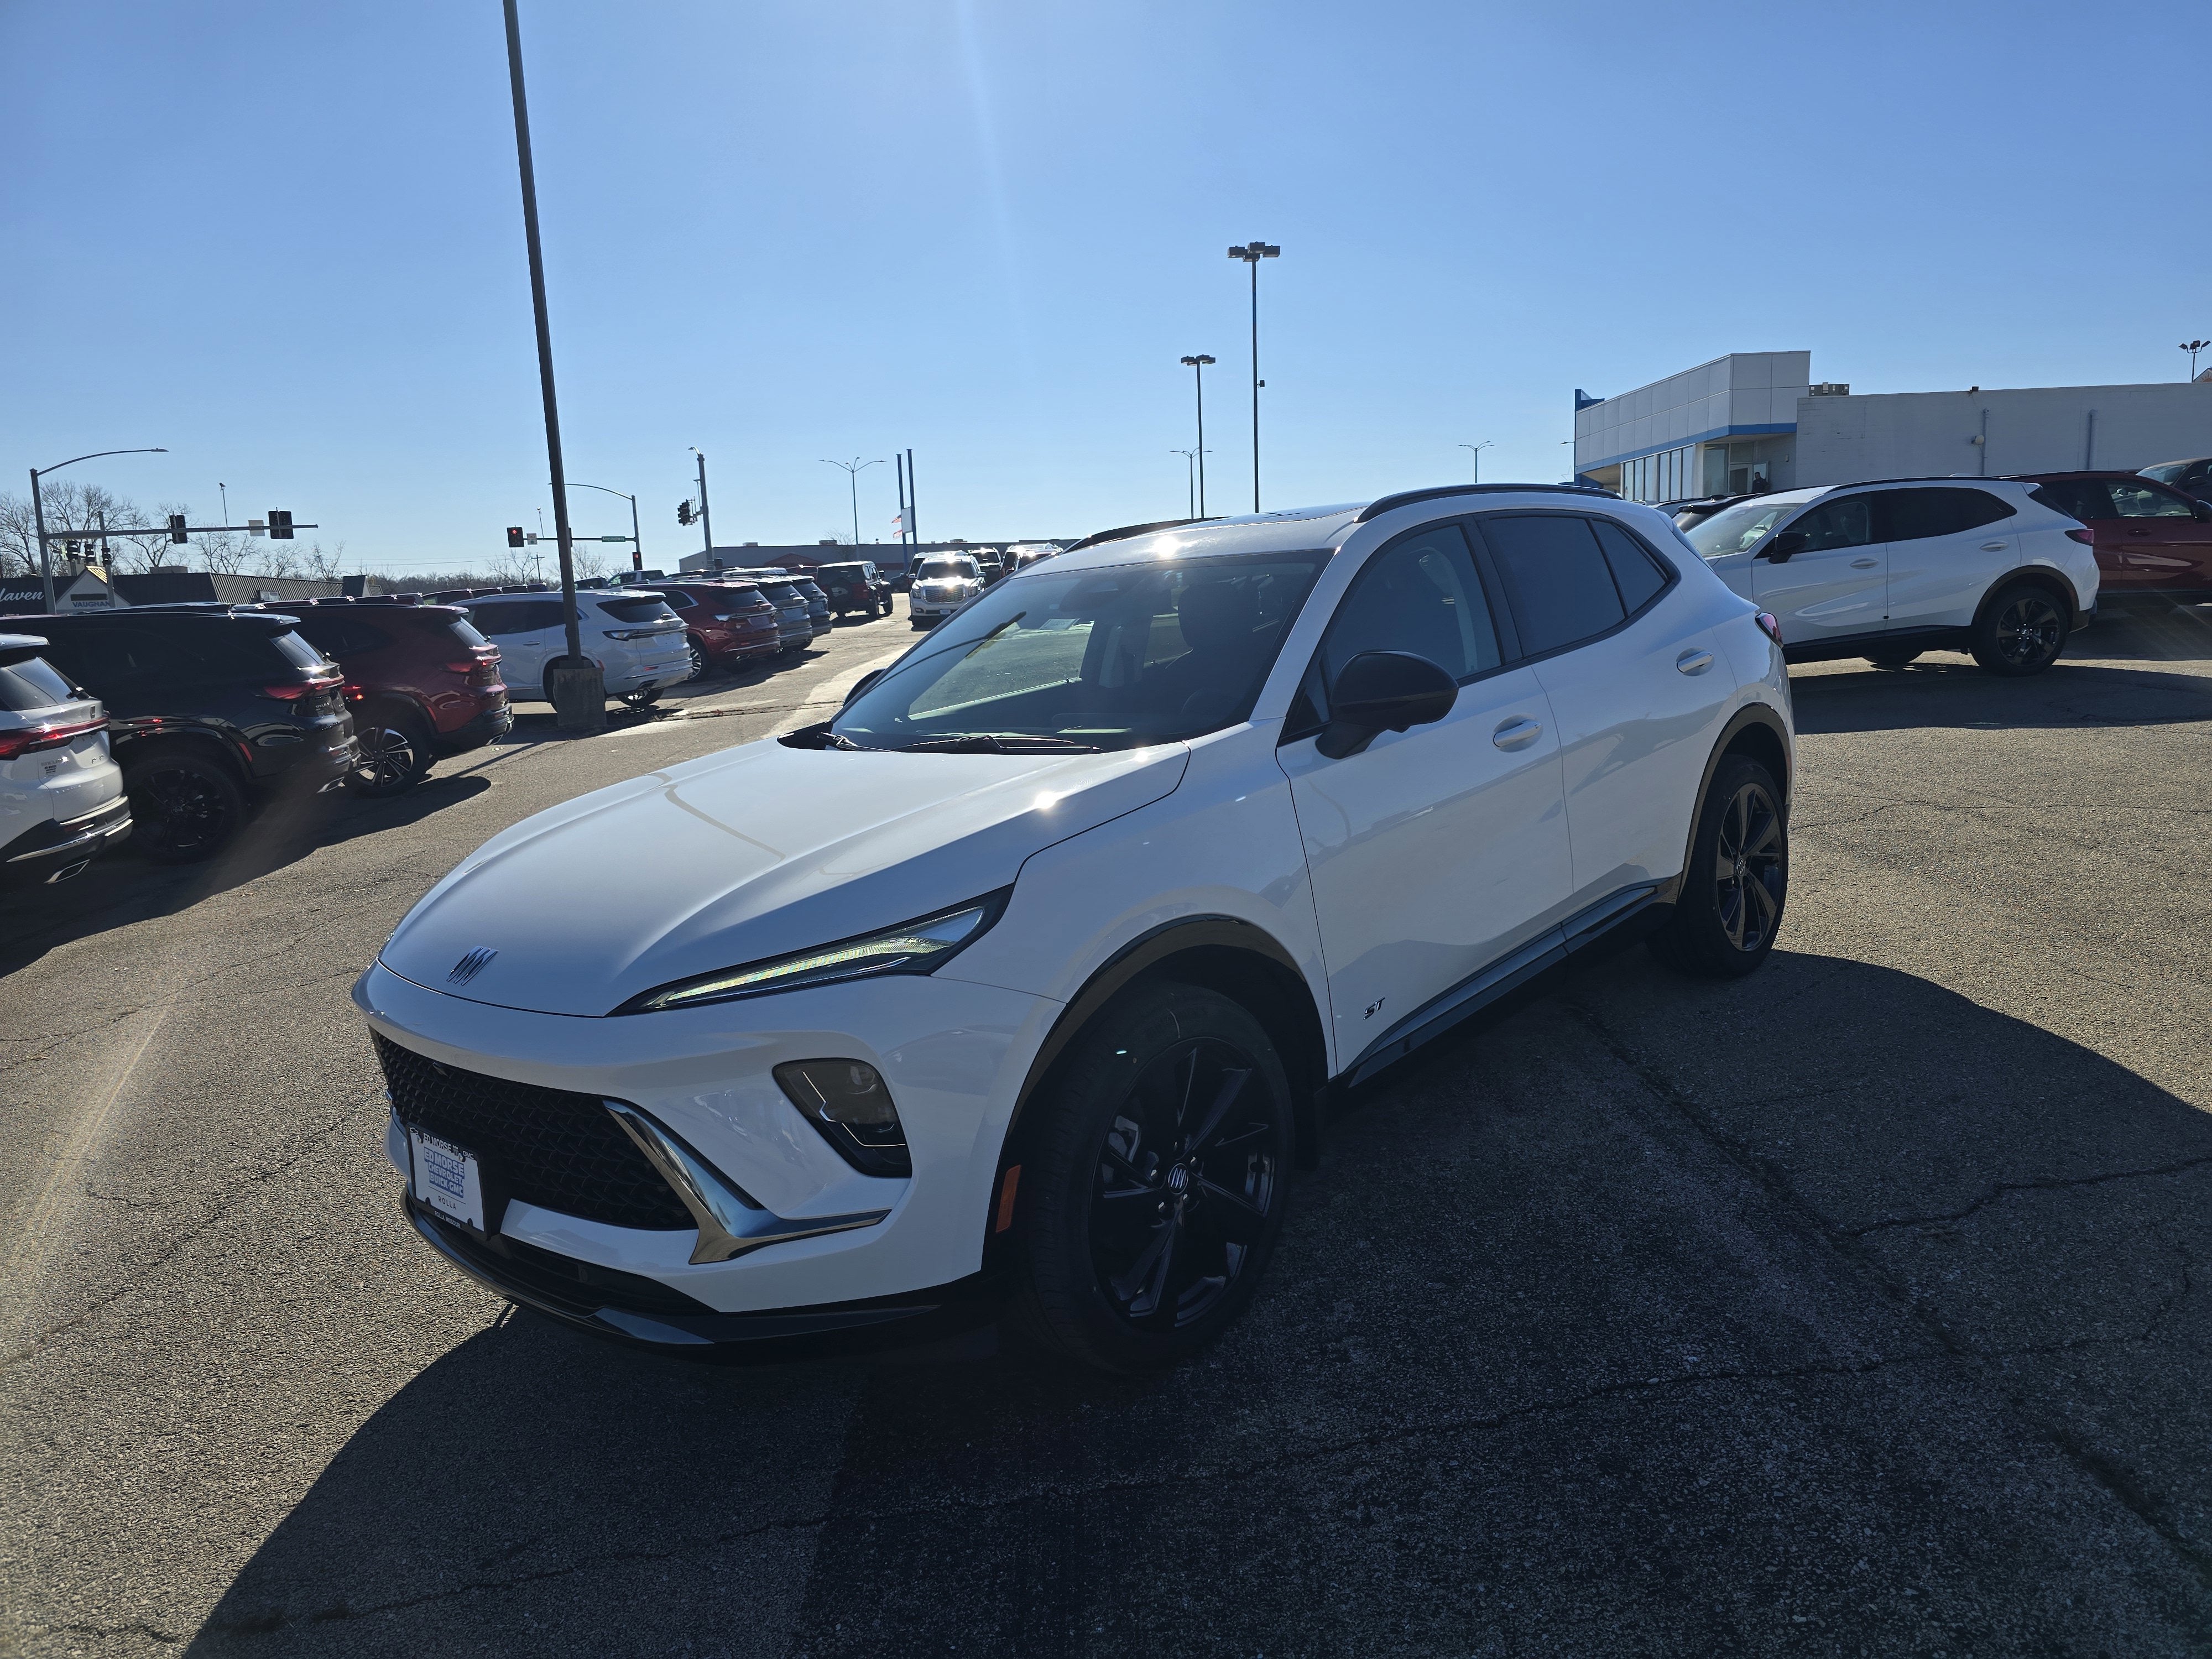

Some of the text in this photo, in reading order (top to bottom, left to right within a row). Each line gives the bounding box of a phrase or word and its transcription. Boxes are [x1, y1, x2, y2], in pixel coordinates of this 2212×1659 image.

[1363, 997, 1386, 1020] ST
[424, 1133, 430, 1142] ED
[431, 1136, 452, 1151] MORSE
[424, 1147, 464, 1176] ED MORSE
[429, 1162, 462, 1185] CHEVROLET
[439, 1196, 456, 1210] ROLLA
